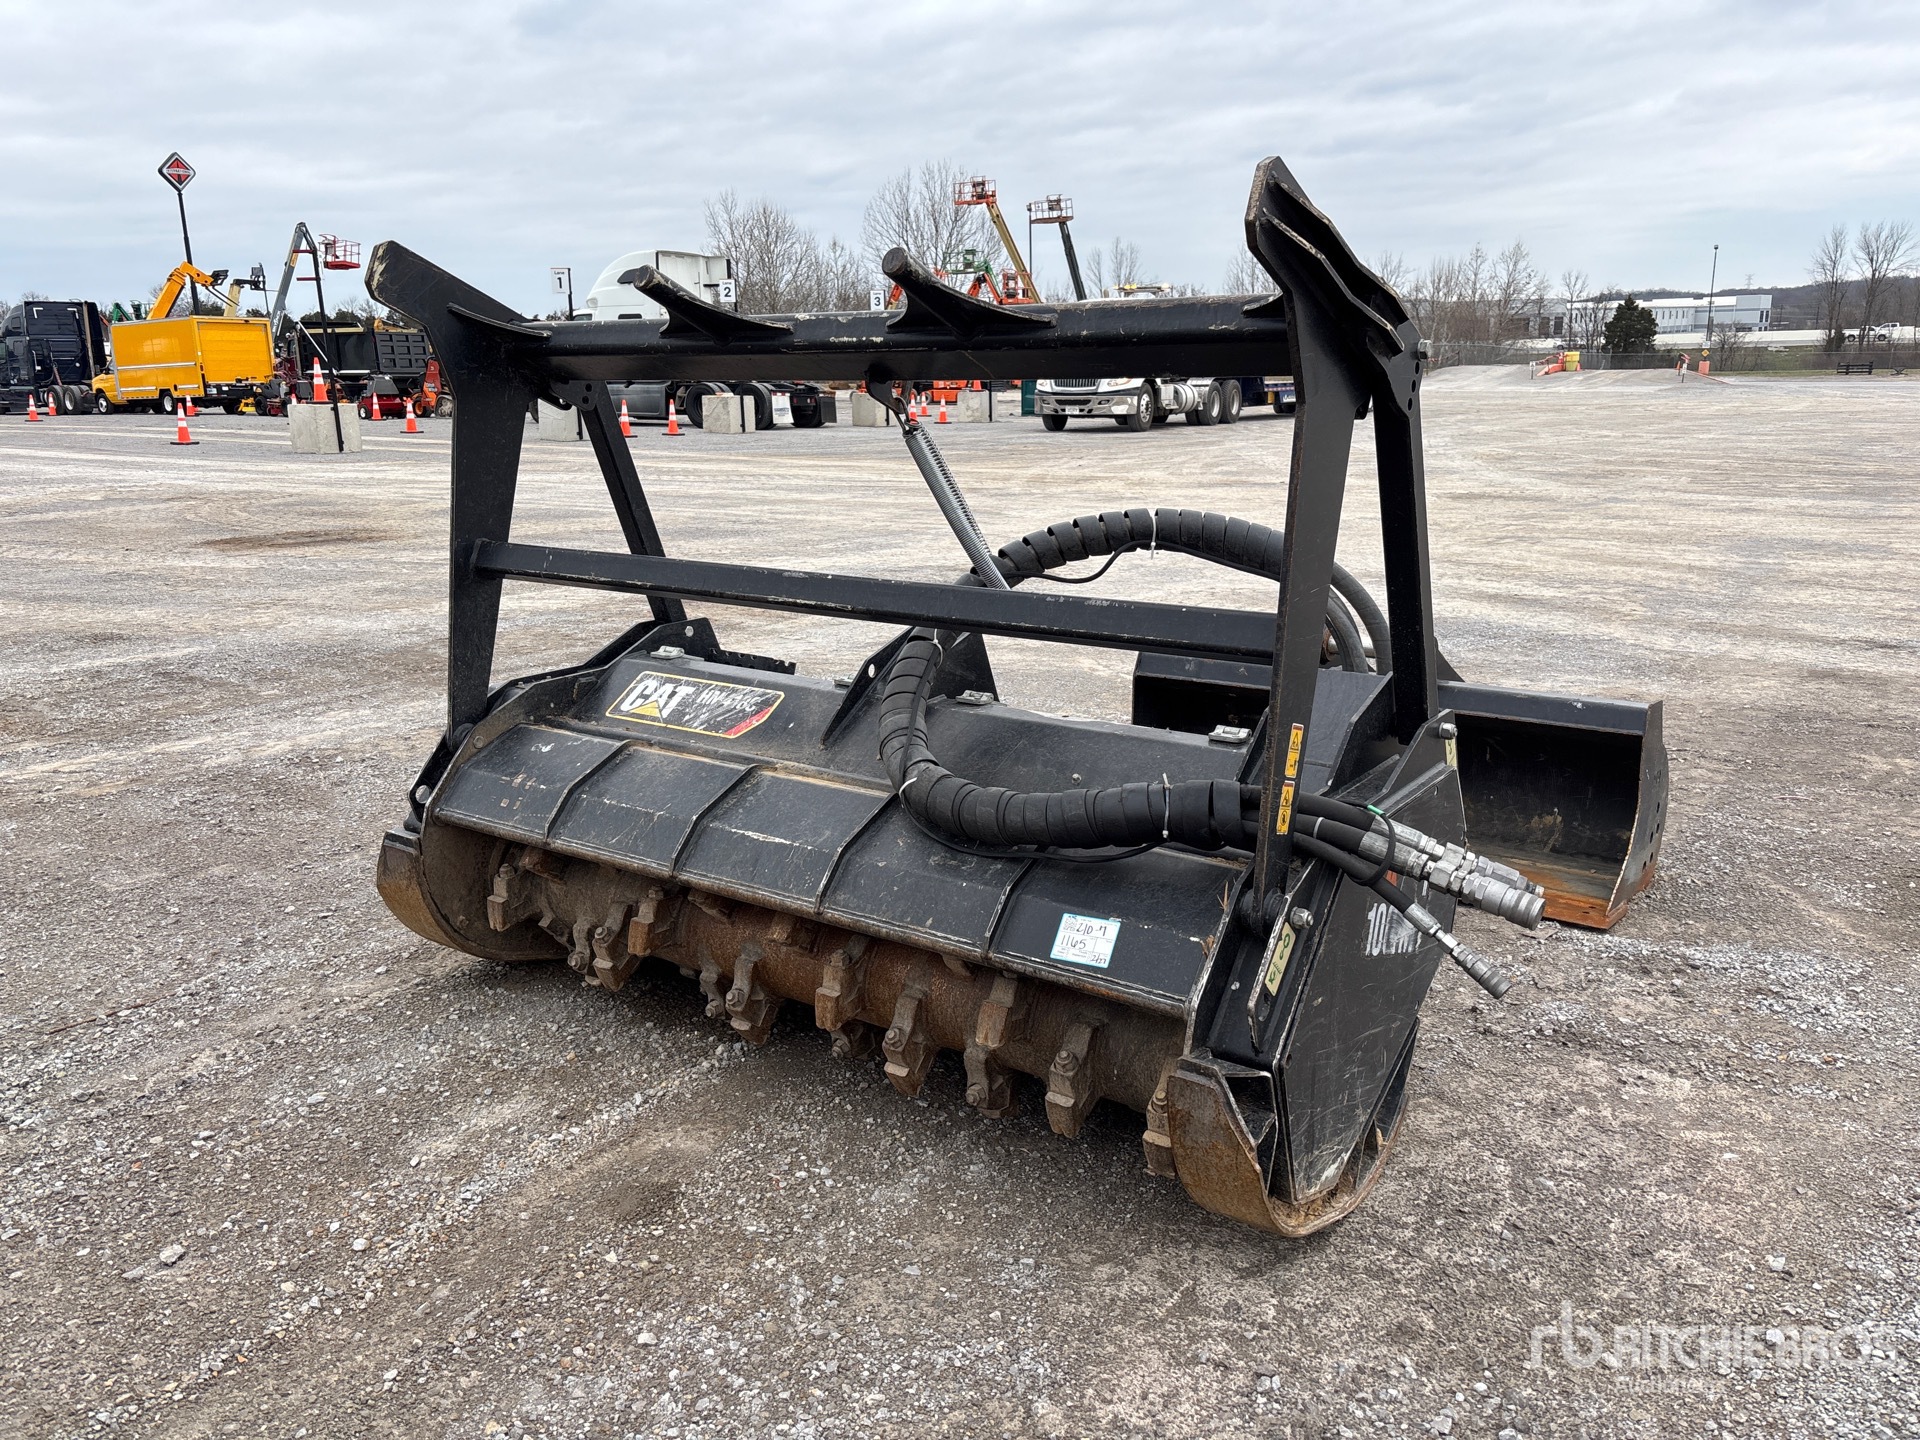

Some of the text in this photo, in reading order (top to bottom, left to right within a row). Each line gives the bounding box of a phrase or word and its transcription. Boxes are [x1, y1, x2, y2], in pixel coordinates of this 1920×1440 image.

[557, 276, 562, 289] 1
[724, 286, 732, 298] 2
[874, 296, 881, 306] 3
[619, 679, 695, 718] CAT
[1060, 934, 1087, 950] 1165
